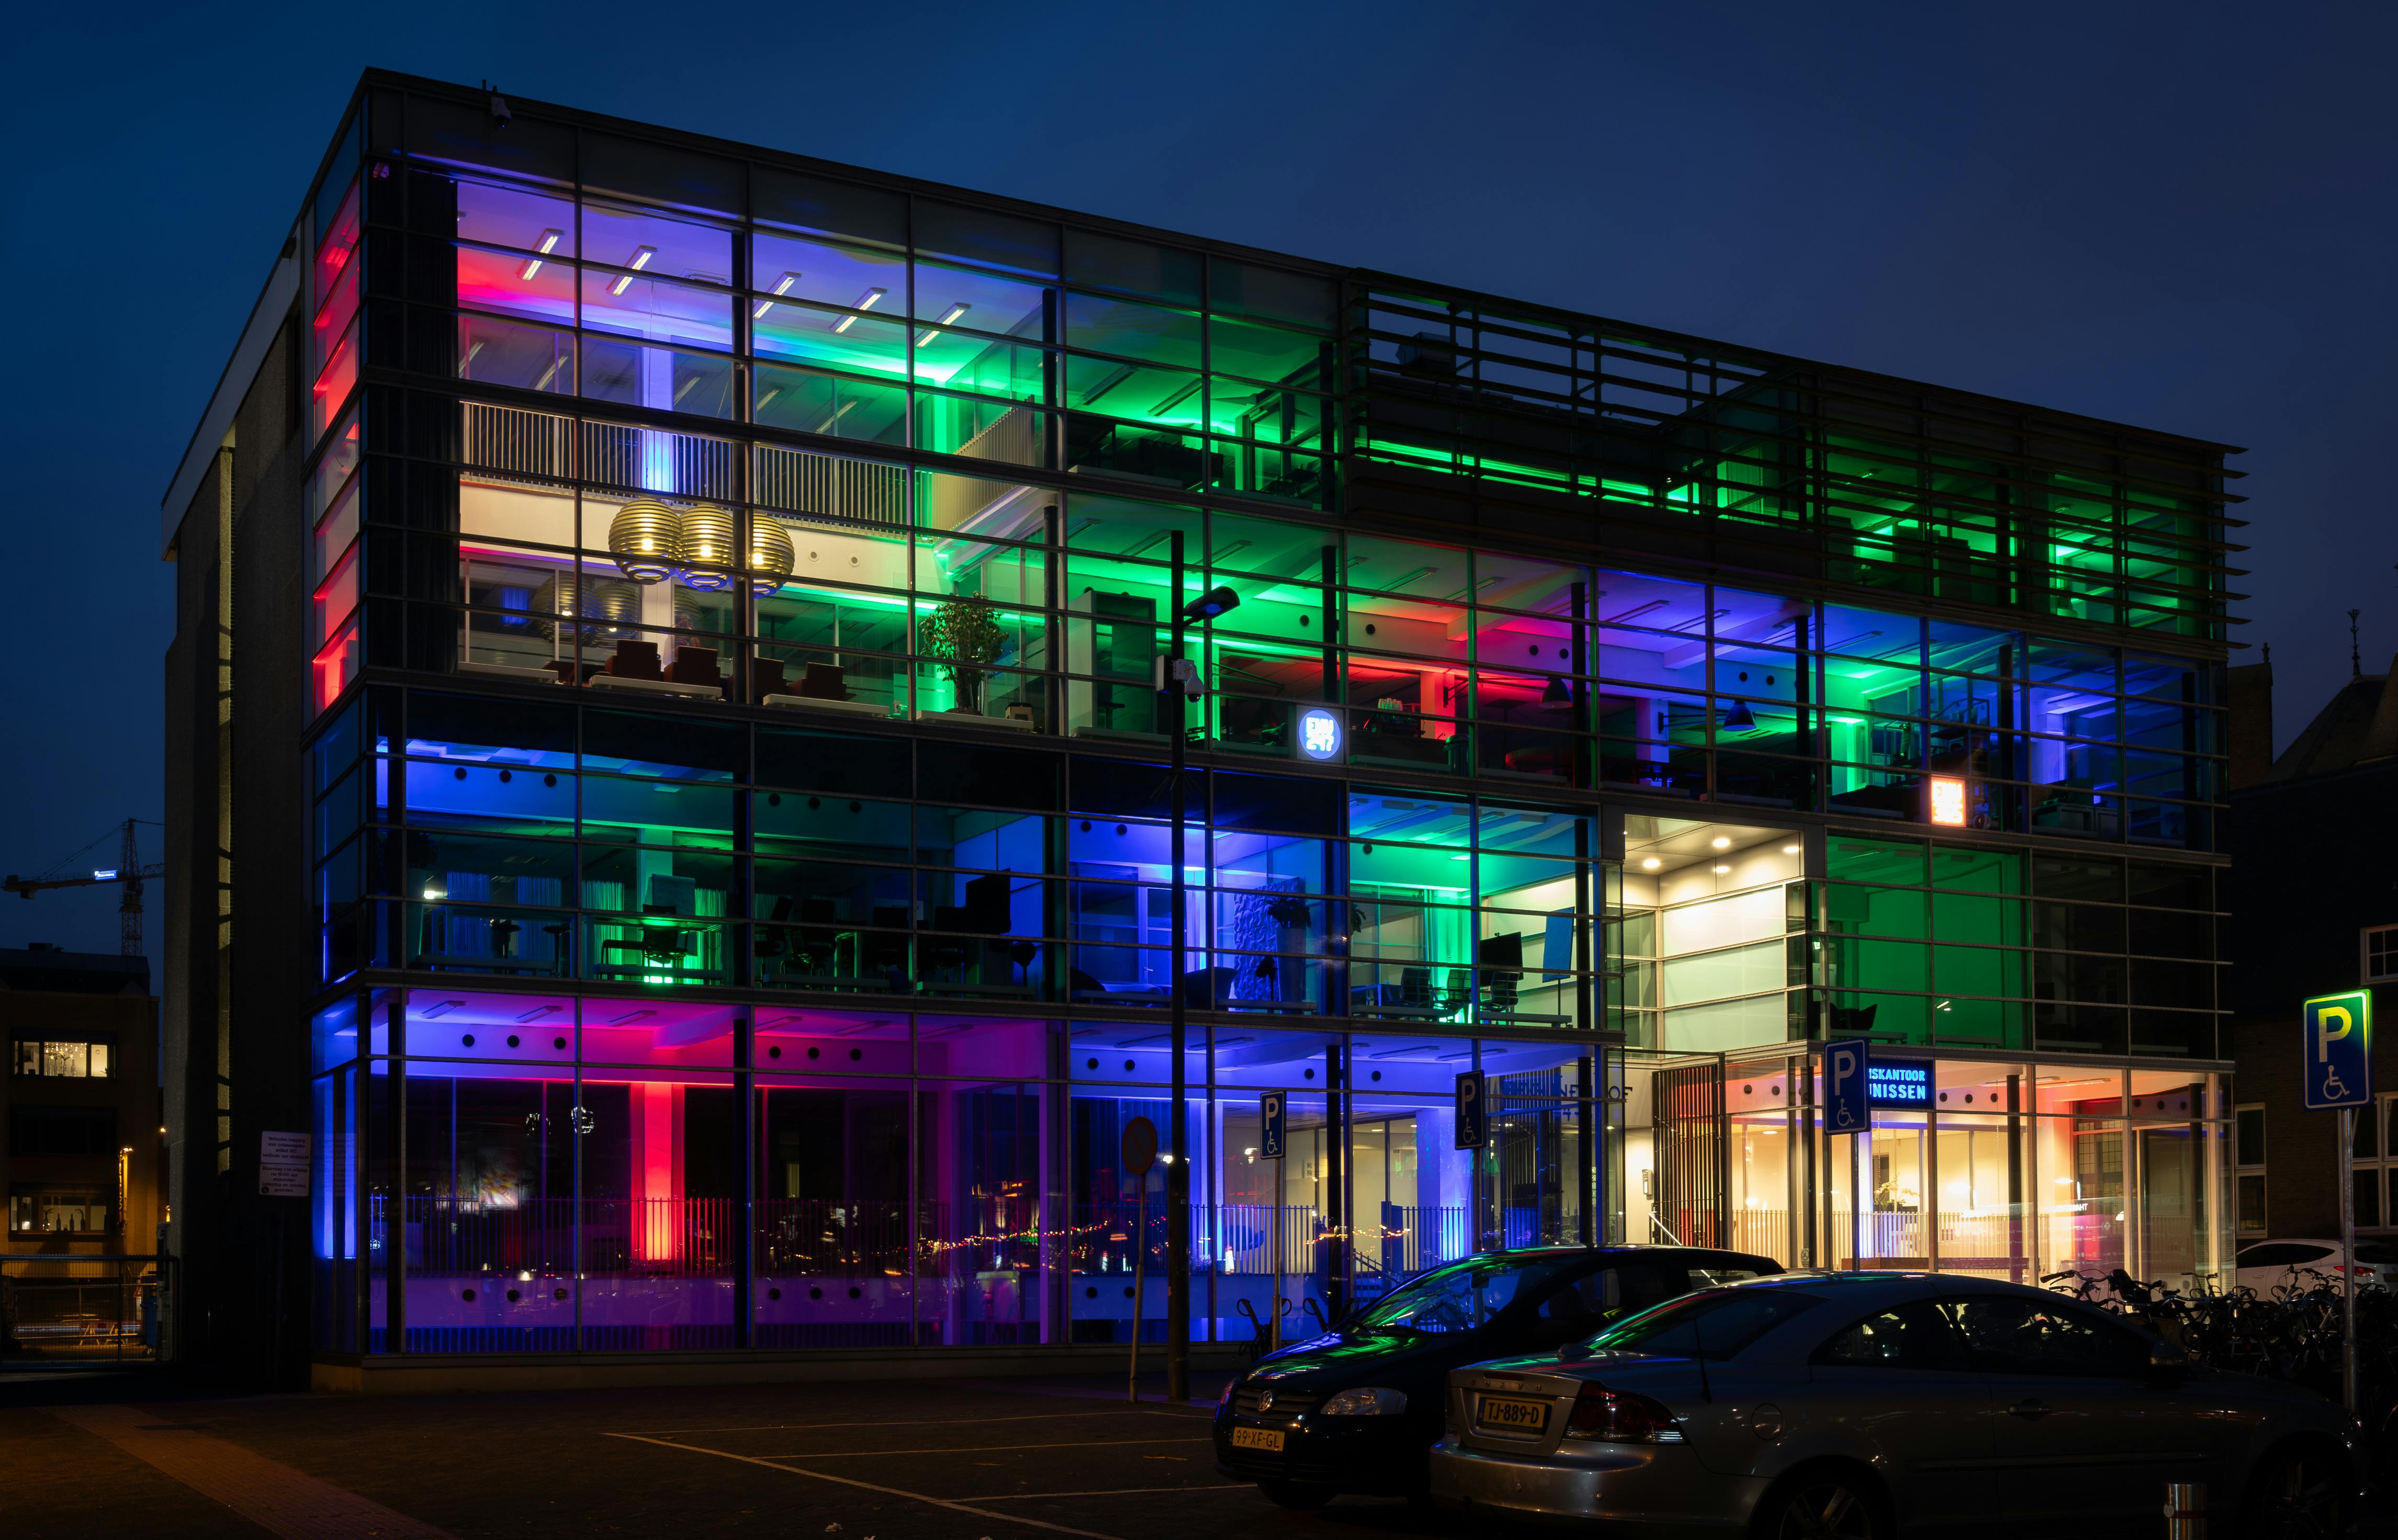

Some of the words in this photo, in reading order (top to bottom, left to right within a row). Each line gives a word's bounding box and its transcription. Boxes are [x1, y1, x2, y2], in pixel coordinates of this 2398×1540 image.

[2318, 1006, 2352, 1062] P
[1834, 1050, 1856, 1096] P
[1265, 1097, 1279, 1130] P
[1461, 1079, 1476, 1116] P
[1488, 1402, 1539, 1424] TJ-889-D
[1236, 1430, 1279, 1448] 99-XF-GL
